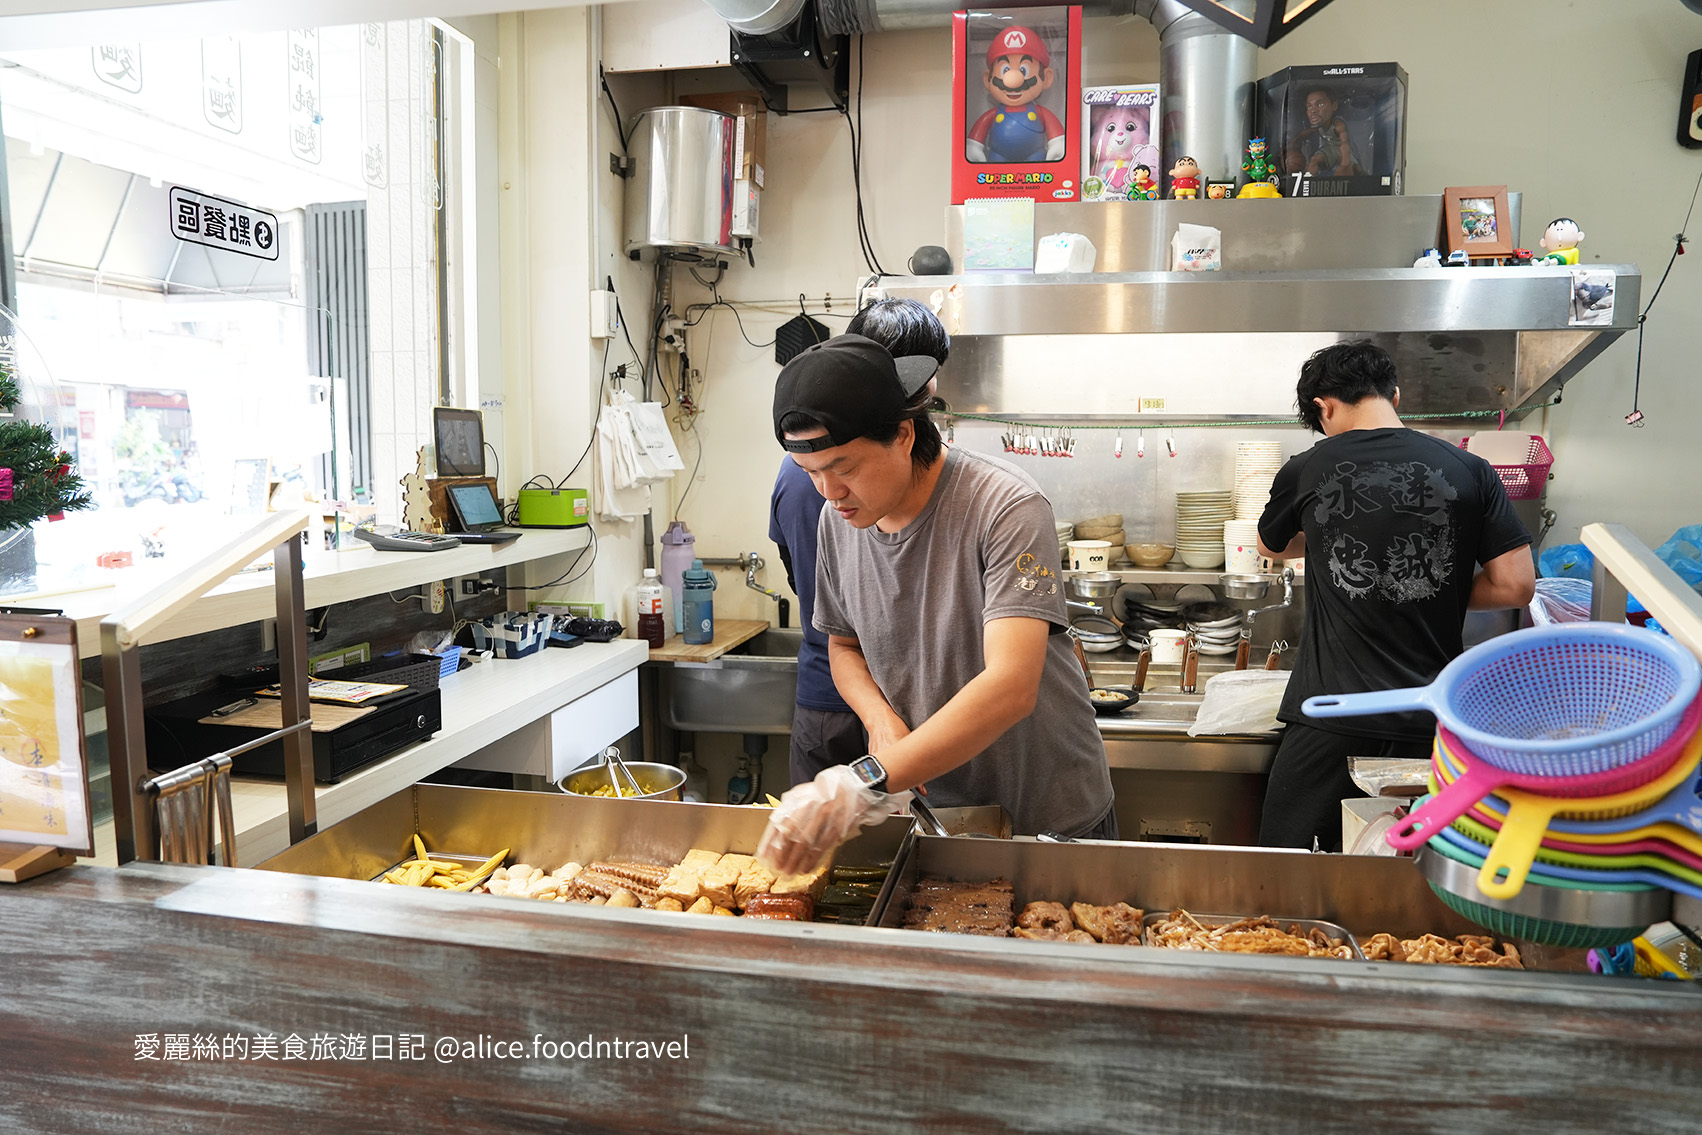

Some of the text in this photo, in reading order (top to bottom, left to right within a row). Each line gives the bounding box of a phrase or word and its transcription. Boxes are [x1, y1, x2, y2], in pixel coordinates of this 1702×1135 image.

[1006, 33, 1024, 46] M
[1084, 89, 1157, 106] CARE BEARS
[977, 173, 1053, 184] SUPER MARIO
[1291, 171, 1302, 196] 7
[1311, 180, 1349, 196] DURANT
[1331, 533, 1442, 592] 忠誠
